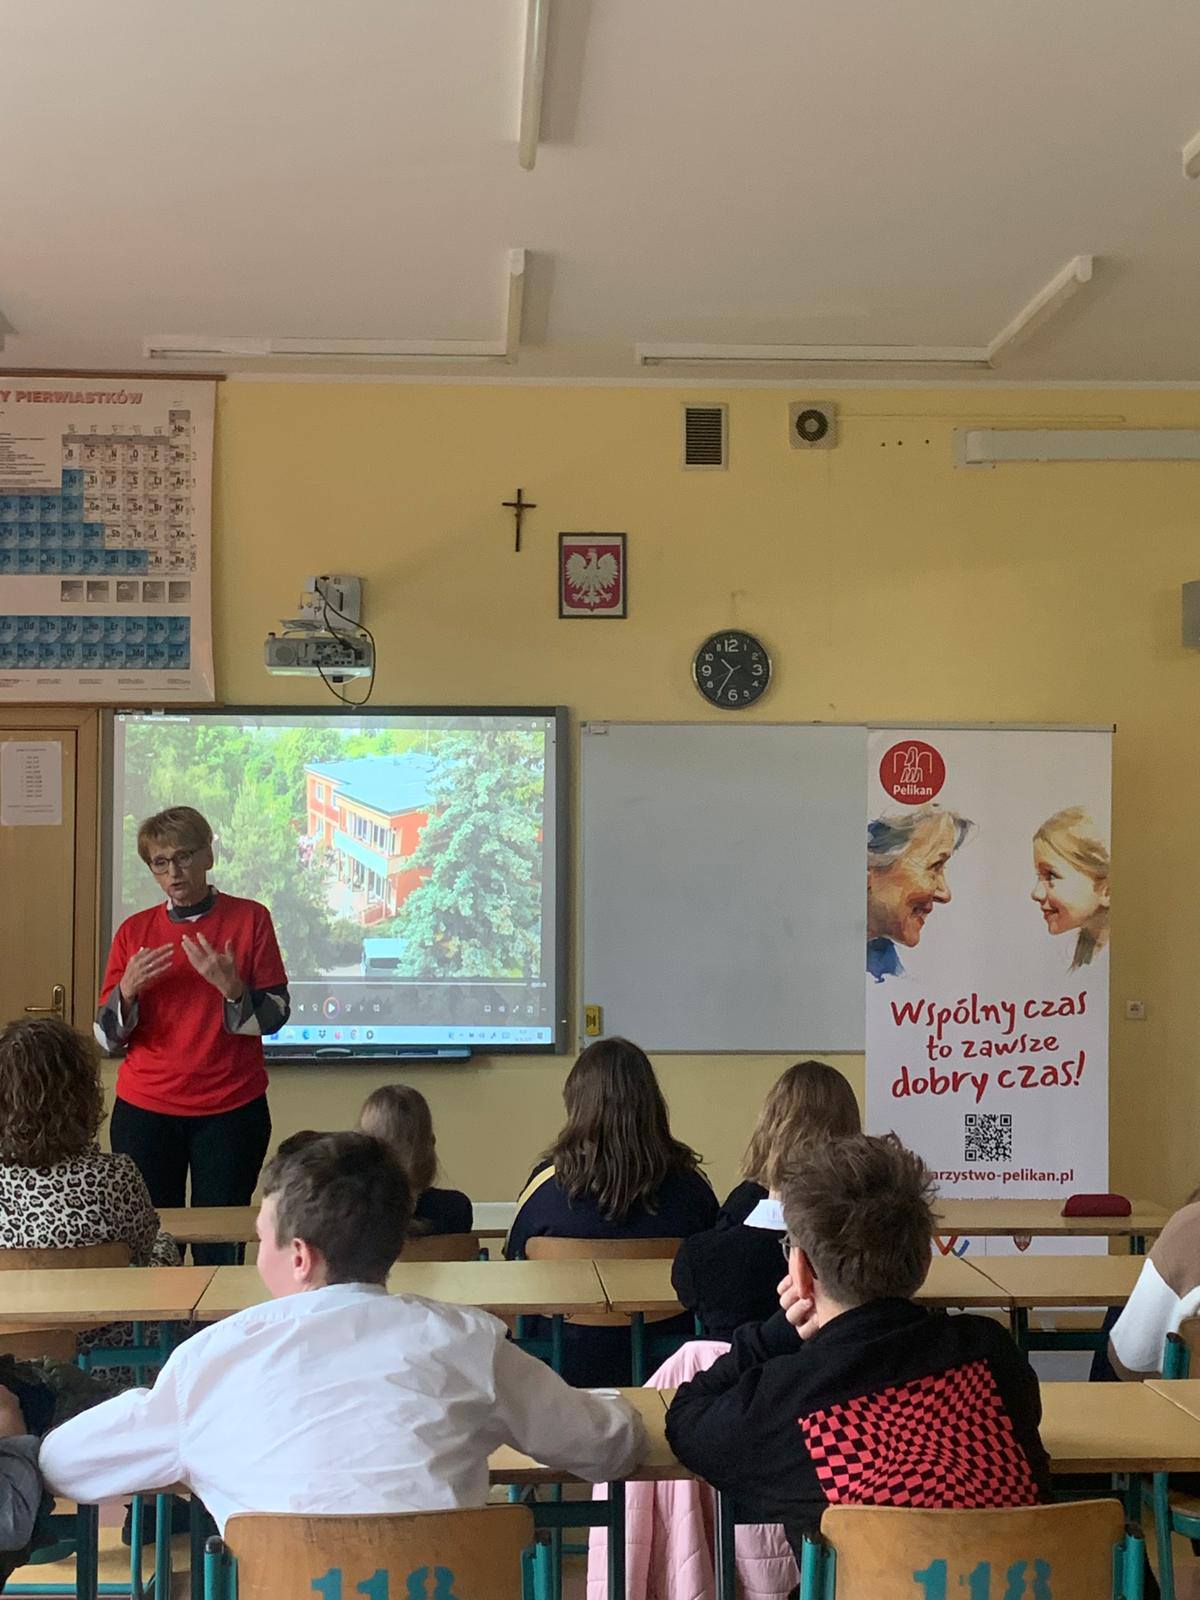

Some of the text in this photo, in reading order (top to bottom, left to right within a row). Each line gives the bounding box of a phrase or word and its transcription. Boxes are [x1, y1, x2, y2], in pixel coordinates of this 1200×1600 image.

[16, 389, 143, 405] PIERWIASTKÓW
[724, 640, 740, 653] 12
[751, 652, 759, 661] 2
[701, 665, 712, 676] 9
[751, 664, 763, 676] 3
[706, 681, 714, 689] 8
[727, 689, 738, 701] 6
[743, 690, 750, 698] 5
[893, 784, 934, 796] Pelikan
[890, 990, 1088, 1040] Wspólny czas
[926, 1032, 1060, 1061] to zawsze
[892, 1049, 1087, 1105] dobry czas!
[931, 1168, 1074, 1184] arzystwo-pelikan.pl
[913, 1558, 1052, 1600] 118
